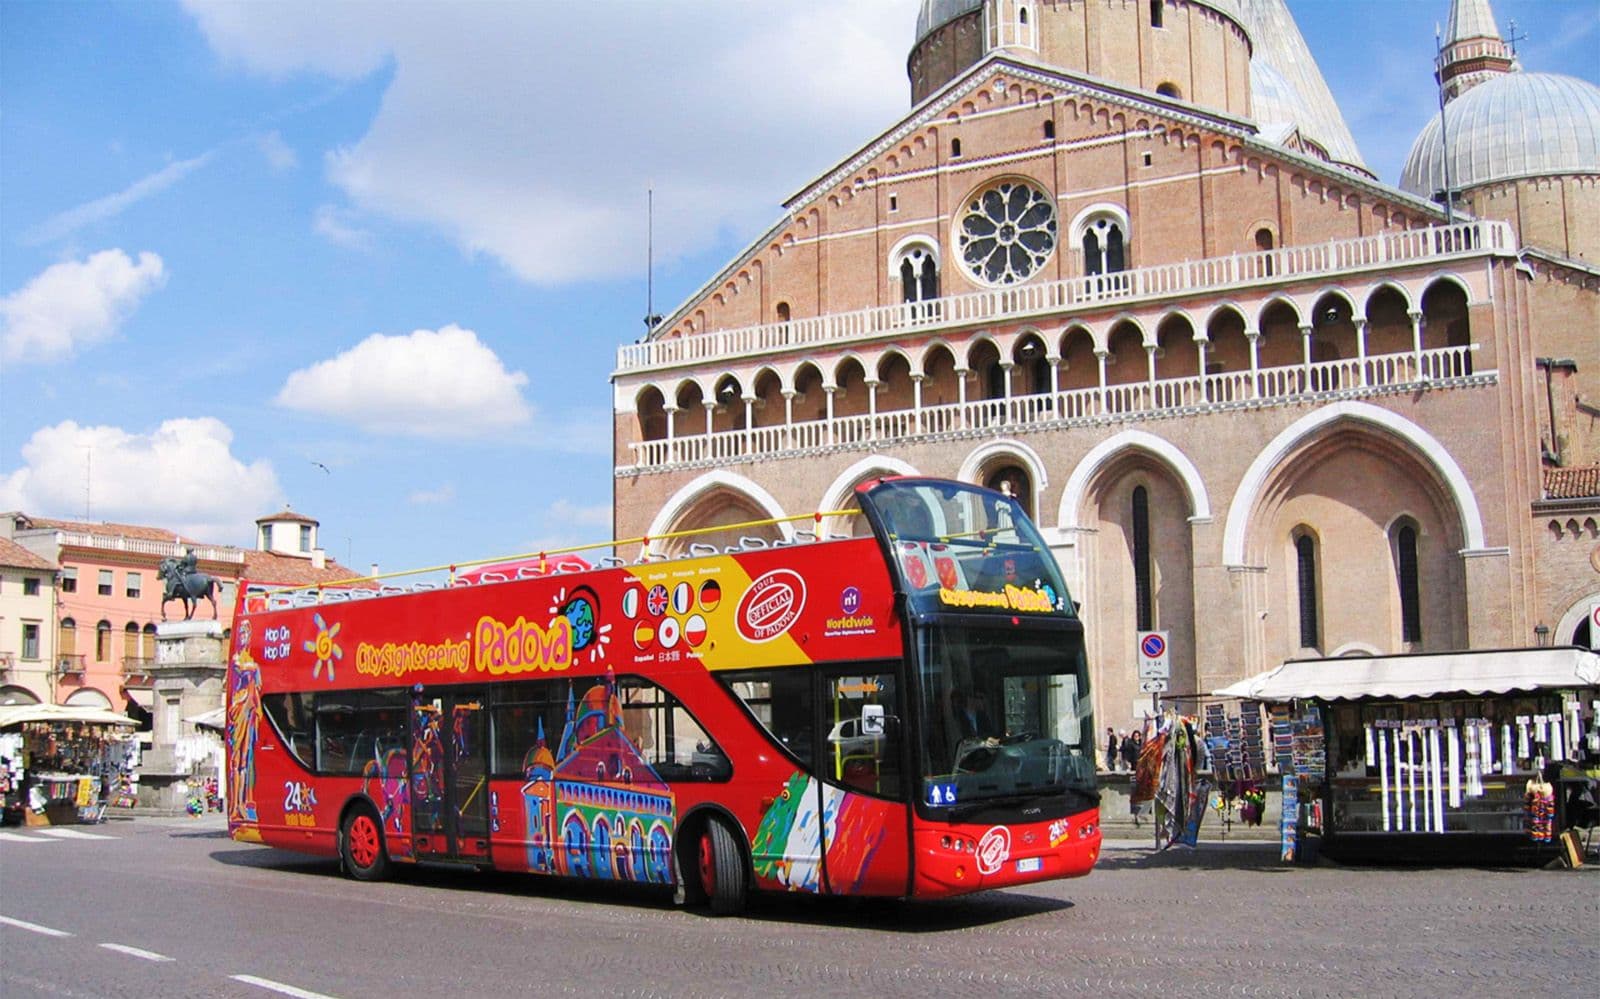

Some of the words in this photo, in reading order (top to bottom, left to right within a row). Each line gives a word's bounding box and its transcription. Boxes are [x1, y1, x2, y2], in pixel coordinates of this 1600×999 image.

[753, 576, 775, 594] TOUR
[749, 590, 791, 623] OFFICIAL
[754, 630, 766, 639] OF
[766, 610, 796, 637] PADOVA
[826, 615, 874, 629] Worldwide
[264, 628, 279, 641] Hop
[280, 625, 290, 640] On
[264, 645, 278, 660] Hop
[279, 643, 291, 658] Off
[474, 615, 573, 676] Padova
